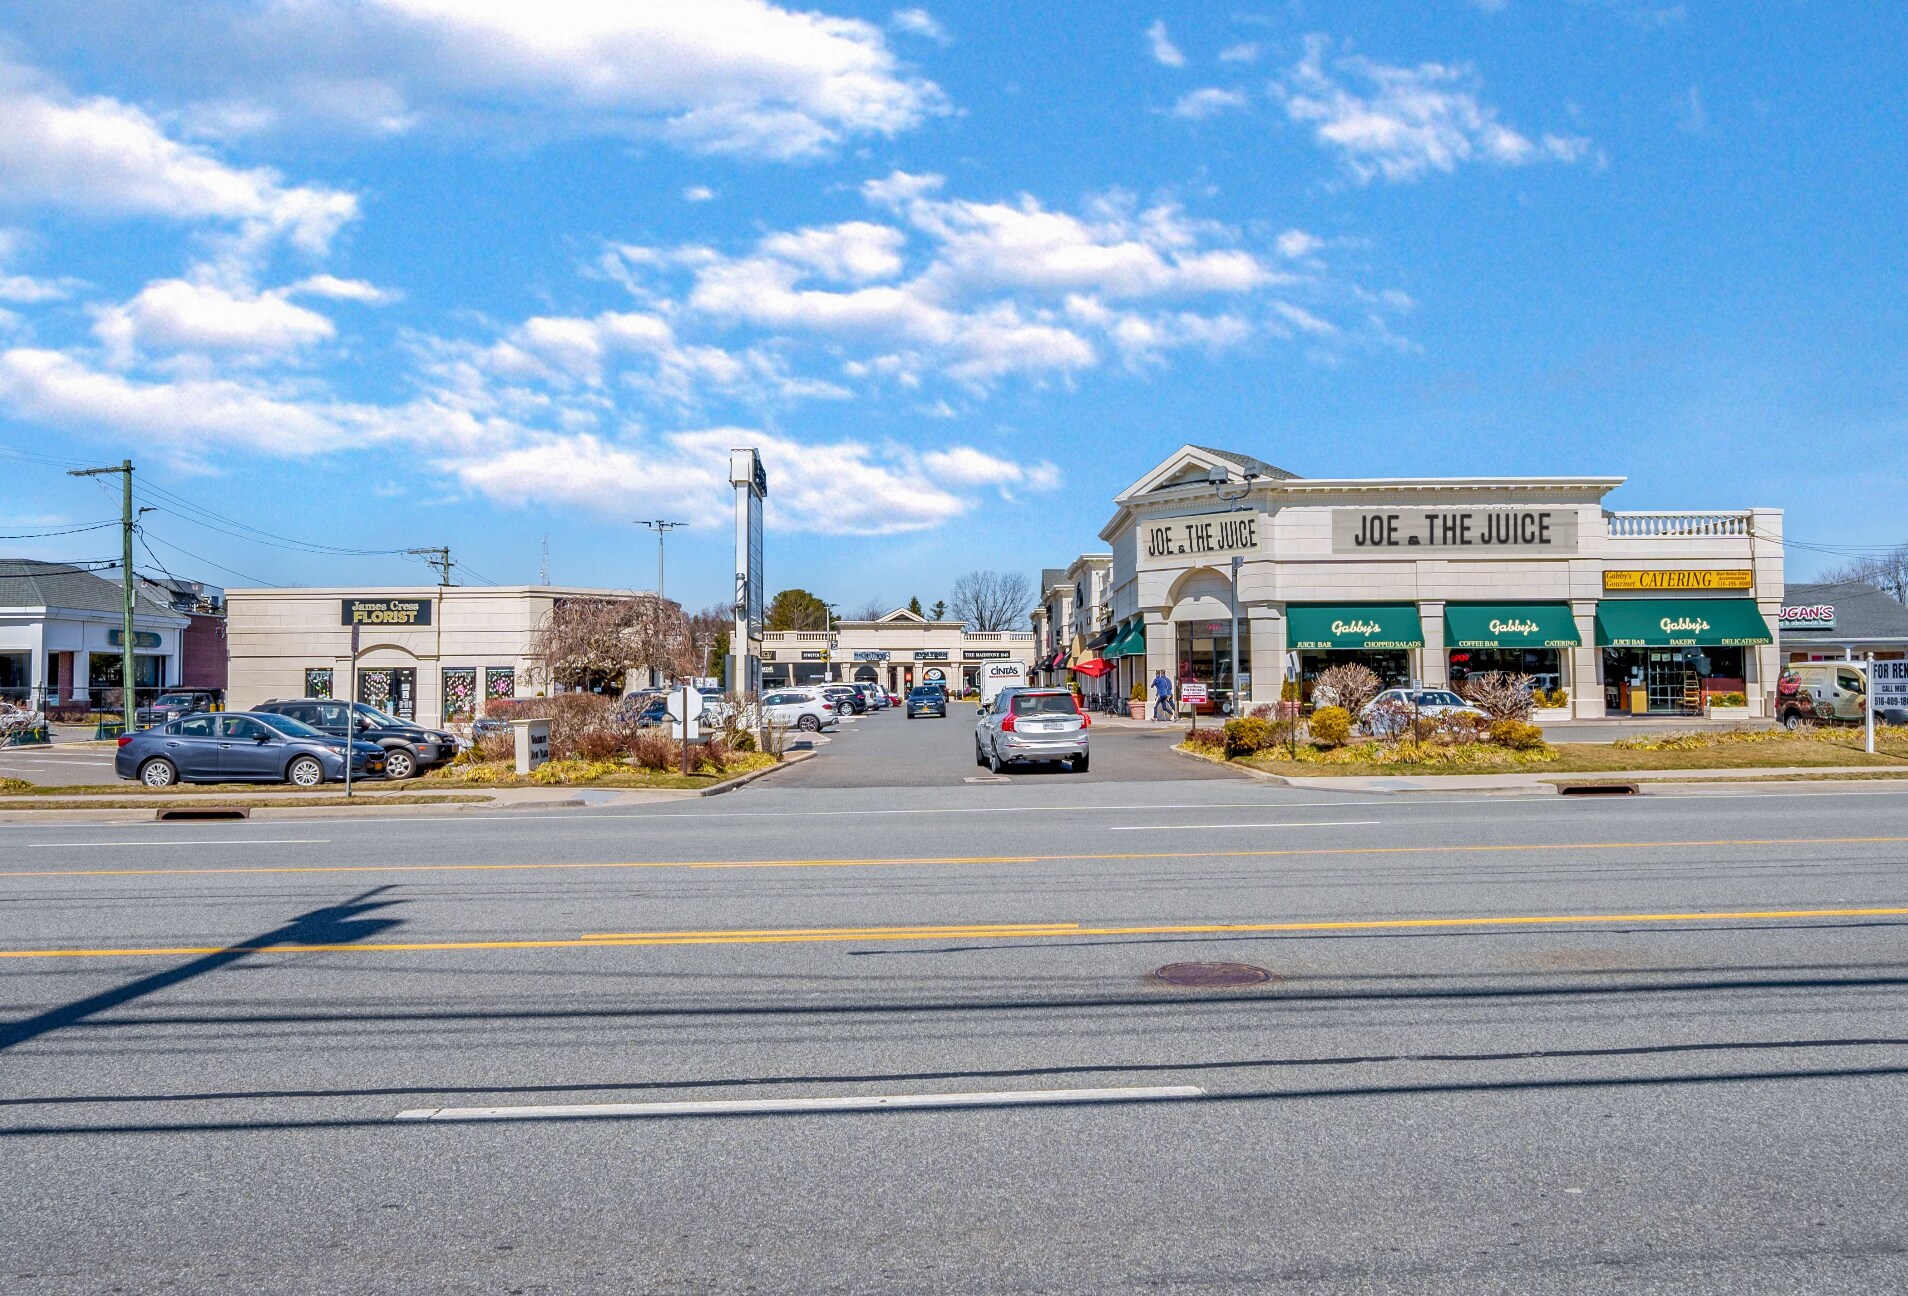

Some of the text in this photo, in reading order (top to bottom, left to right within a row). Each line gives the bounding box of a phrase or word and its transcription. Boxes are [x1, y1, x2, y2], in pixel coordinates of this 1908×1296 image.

[1148, 518, 1258, 556] JOE & THE JUICE
[1354, 512, 1551, 546] JOE & THE JUICE
[1606, 571, 1712, 588] Gabby's CATERING
[1606, 579, 1636, 588] Gourmet
[351, 600, 419, 611] James Cress
[353, 611, 418, 623] FLORIST
[1331, 620, 1382, 637] Gabby's
[1489, 619, 1540, 636] Gabby's
[1660, 617, 1711, 634] Gabby's
[1670, 638, 1697, 646] BAKERY
[1721, 637, 1769, 646] DELICATESSEN
[1873, 663, 1889, 679] FOR
[1882, 684, 1894, 693] CALL
